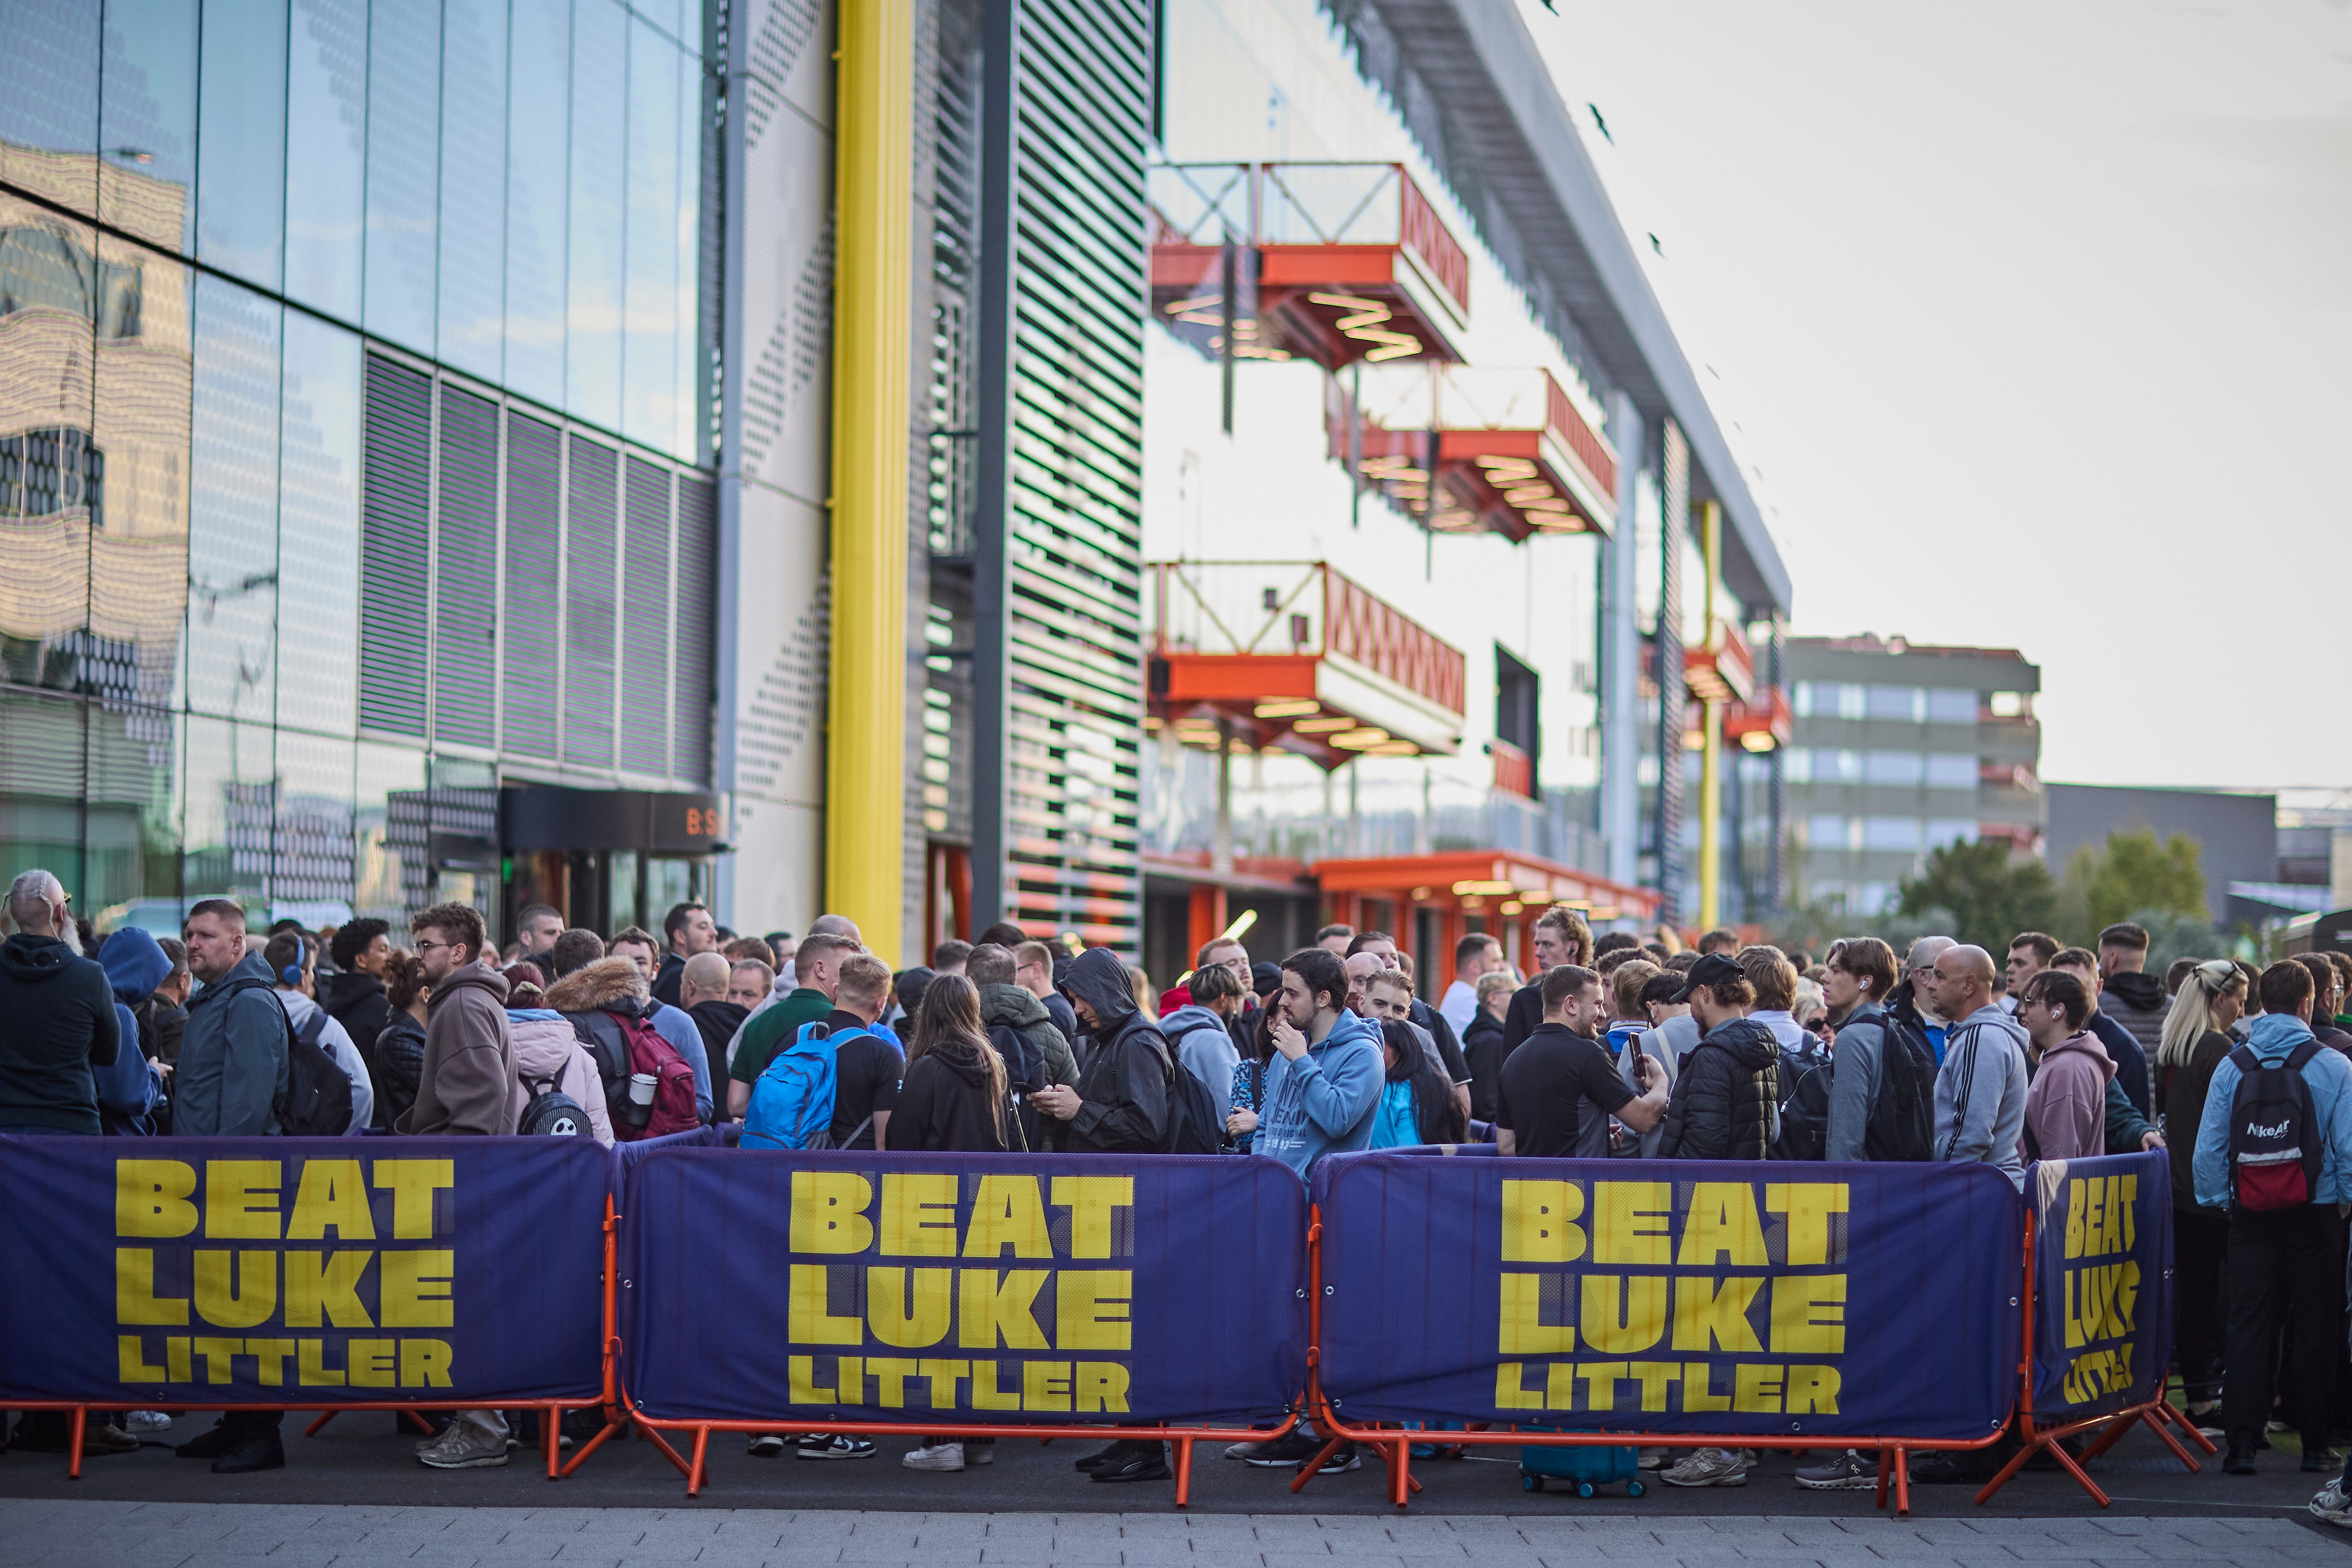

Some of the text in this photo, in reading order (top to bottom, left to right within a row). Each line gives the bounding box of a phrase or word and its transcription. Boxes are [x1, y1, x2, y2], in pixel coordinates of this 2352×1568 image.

[1271, 1139, 1289, 1150] 1993
[116, 1159, 454, 1240] BEAT
[789, 1170, 1133, 1259] BEAT
[1501, 1179, 1849, 1266] BEAT
[2065, 1174, 2137, 1260] BEAT
[116, 1248, 454, 1328] LUKE
[788, 1264, 1133, 1351] LUKE
[1499, 1273, 1848, 1354] LUKE
[118, 1335, 454, 1388] LITTLER
[788, 1355, 1130, 1413] LITTLER
[1495, 1361, 1841, 1415] LITTLER
